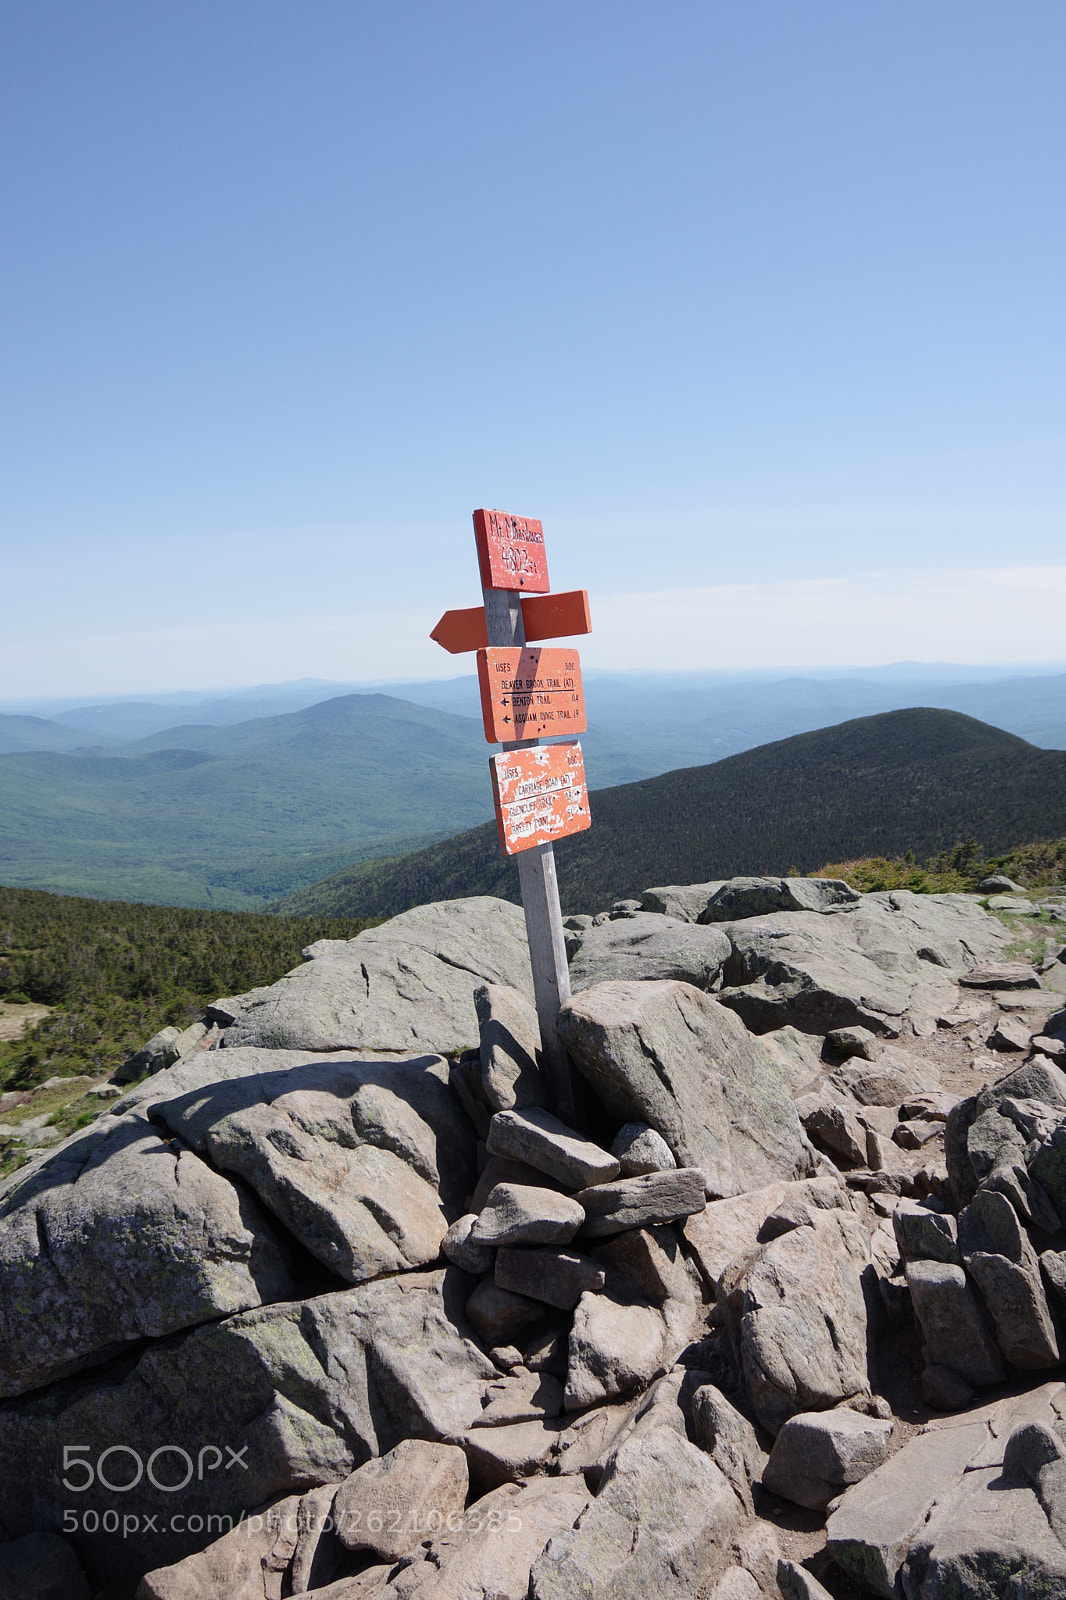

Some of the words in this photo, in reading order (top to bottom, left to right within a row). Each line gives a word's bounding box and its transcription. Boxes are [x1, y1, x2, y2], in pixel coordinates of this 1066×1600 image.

[501, 680, 523, 690] BEAVER
[525, 679, 544, 689] BROOK
[547, 678, 561, 688] TRAIL
[512, 695, 534, 707] BENTON
[537, 695, 551, 705] TRAIL
[540, 711, 555, 721] RIDGE
[557, 710, 571, 719] TRAIL
